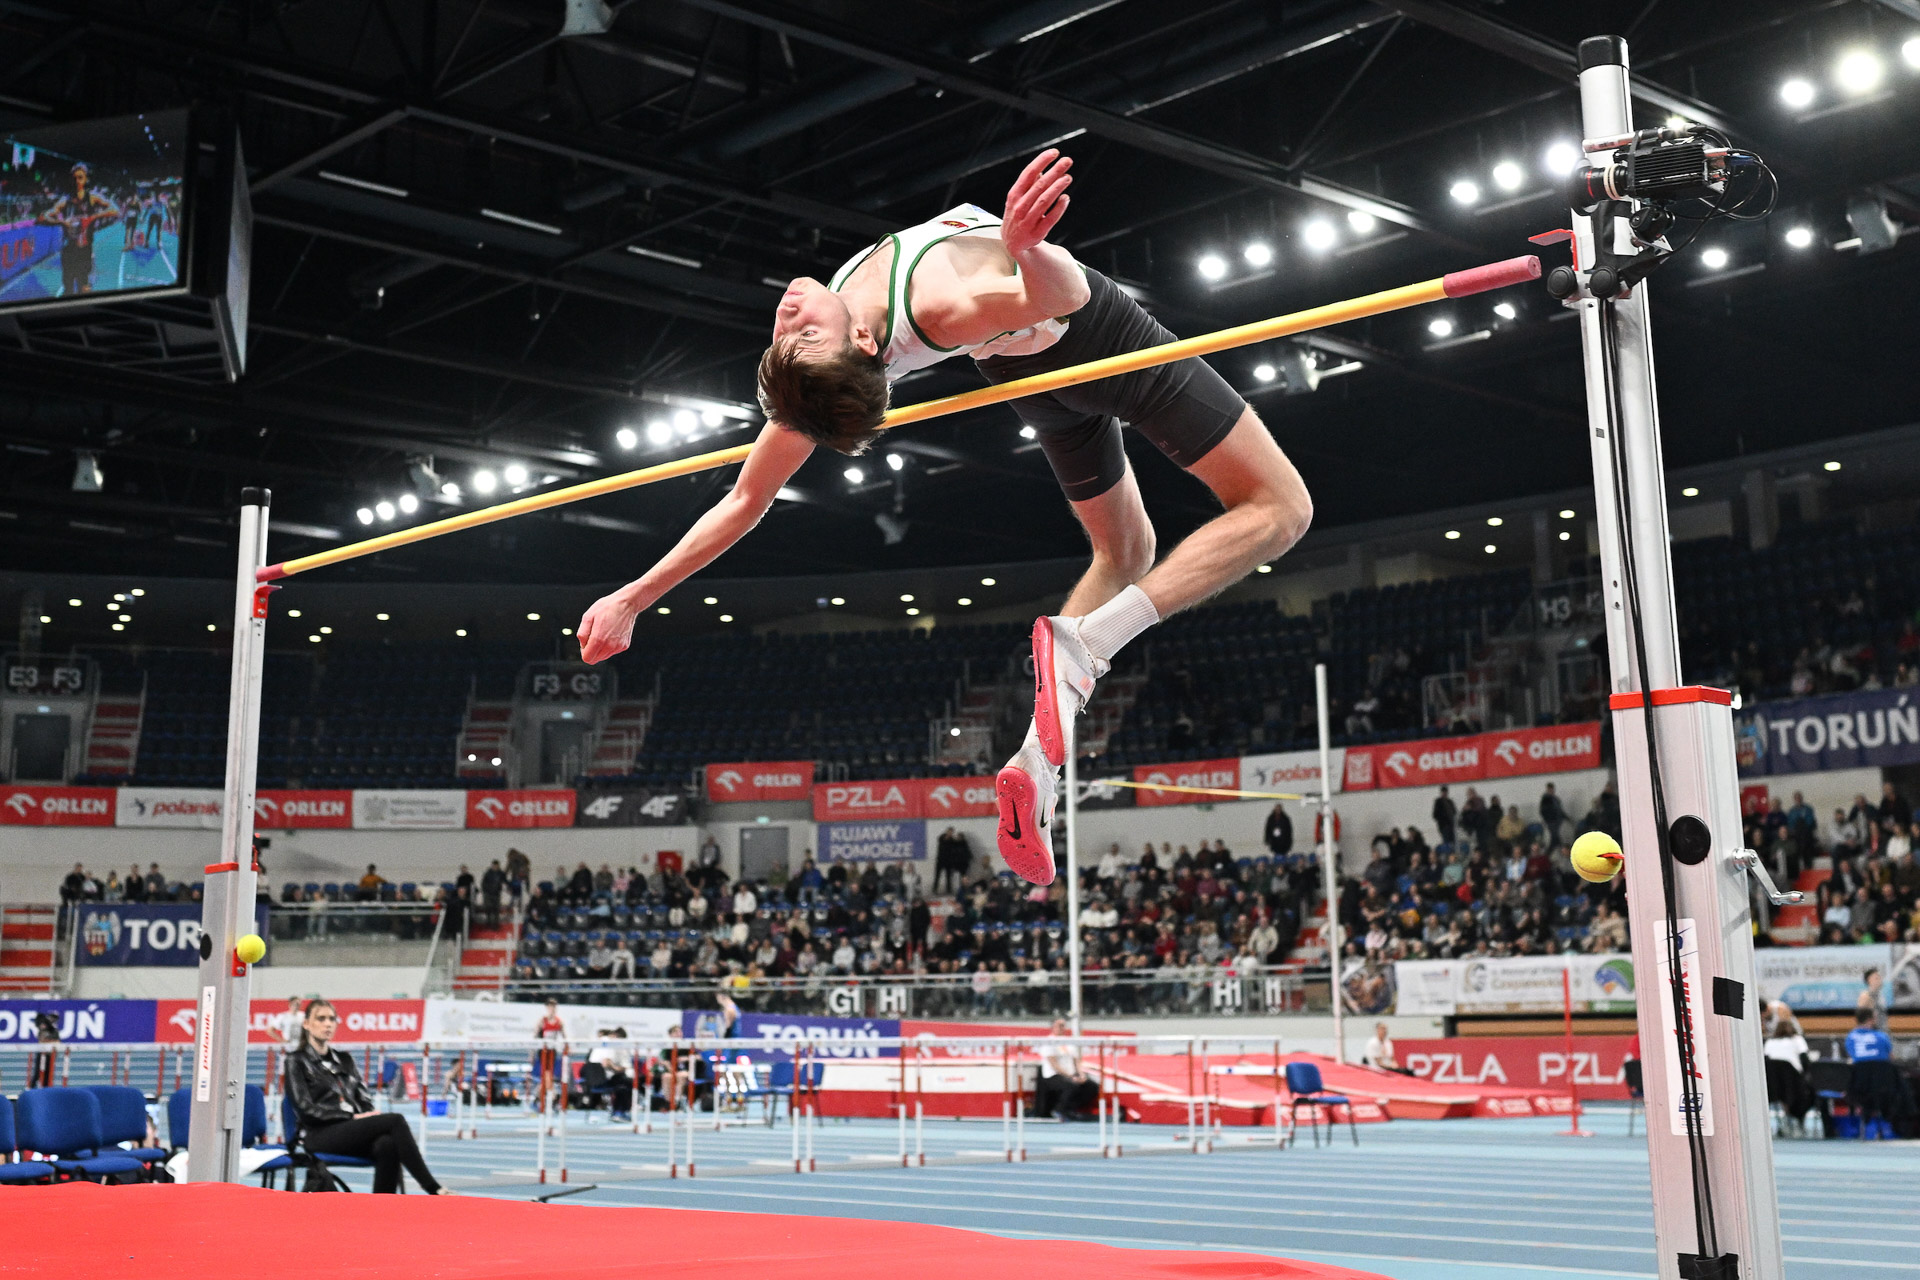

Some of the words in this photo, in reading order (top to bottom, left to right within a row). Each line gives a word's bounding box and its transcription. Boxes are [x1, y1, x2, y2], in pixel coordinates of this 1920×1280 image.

[9, 666, 38, 687] E3
[53, 667, 81, 689] F3
[533, 674, 560, 695] F3
[571, 673, 600, 694] G3
[1769, 694, 1919, 756] TORUŃ
[1418, 747, 1479, 771] ORLEN
[1528, 736, 1592, 759] ORLEN
[753, 773, 802, 788] ORLEN
[1177, 771, 1234, 789] ORLEN
[42, 798, 108, 815] ORLEN
[584, 796, 624, 819] 4F
[639, 795, 679, 818] 4F
[826, 785, 906, 809] PZLA
[963, 788, 998, 805] ORL
[282, 801, 345, 817] ORLEN
[508, 800, 569, 817] ORLEN
[829, 824, 900, 843] KUJAWY
[829, 841, 914, 860] POMORZE
[123, 918, 201, 951] TOR
[828, 984, 861, 1014] G1
[879, 984, 907, 1013] H1
[1213, 979, 1242, 1007] H1
[346, 1012, 417, 1032] ORLEN
[757, 1022, 880, 1058] TORUŃ
[1406, 1052, 1508, 1085] PZLA
